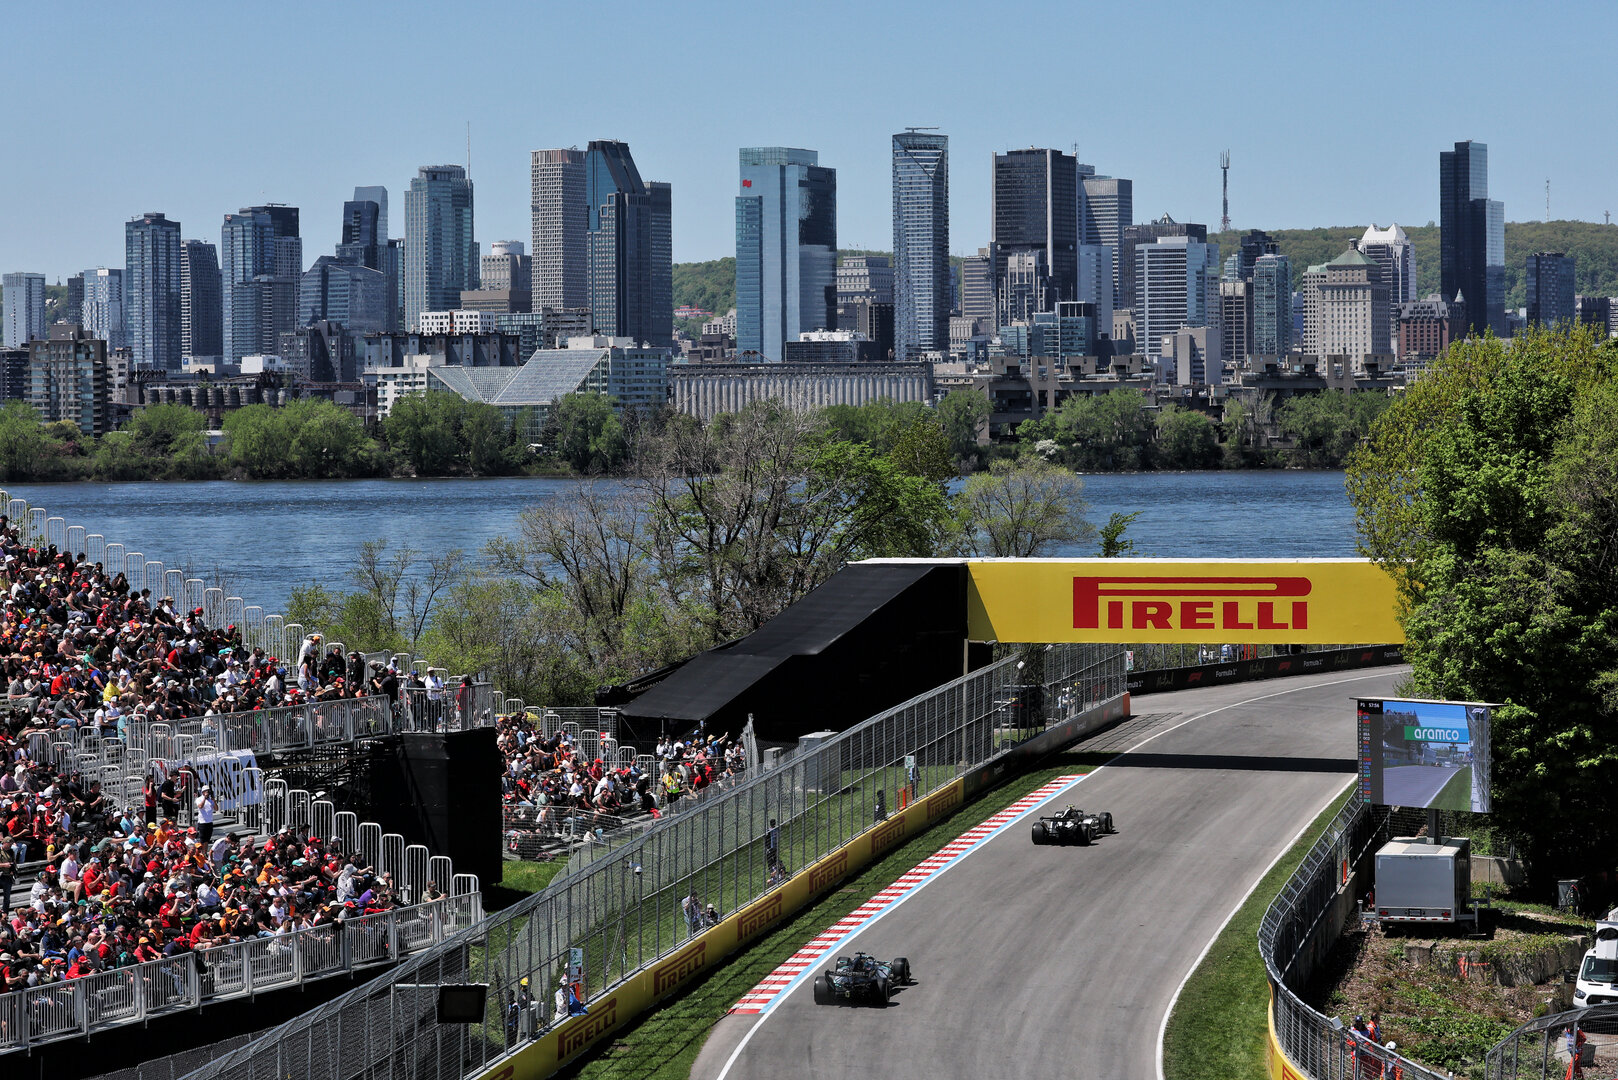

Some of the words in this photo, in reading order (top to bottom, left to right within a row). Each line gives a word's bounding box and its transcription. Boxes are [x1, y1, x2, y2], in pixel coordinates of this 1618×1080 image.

[1073, 577, 1312, 630] PIRELLI
[1216, 669, 1233, 679] Formula
[1303, 659, 1319, 668] Formula
[1414, 728, 1460, 741] aramco
[927, 784, 959, 820] PIRELLI
[871, 815, 906, 854] PIRELLI
[808, 850, 848, 895] PIRELLI
[737, 892, 783, 942] PIRELLI
[653, 940, 706, 997] PIRELLI
[557, 997, 617, 1062] PIRELLI
